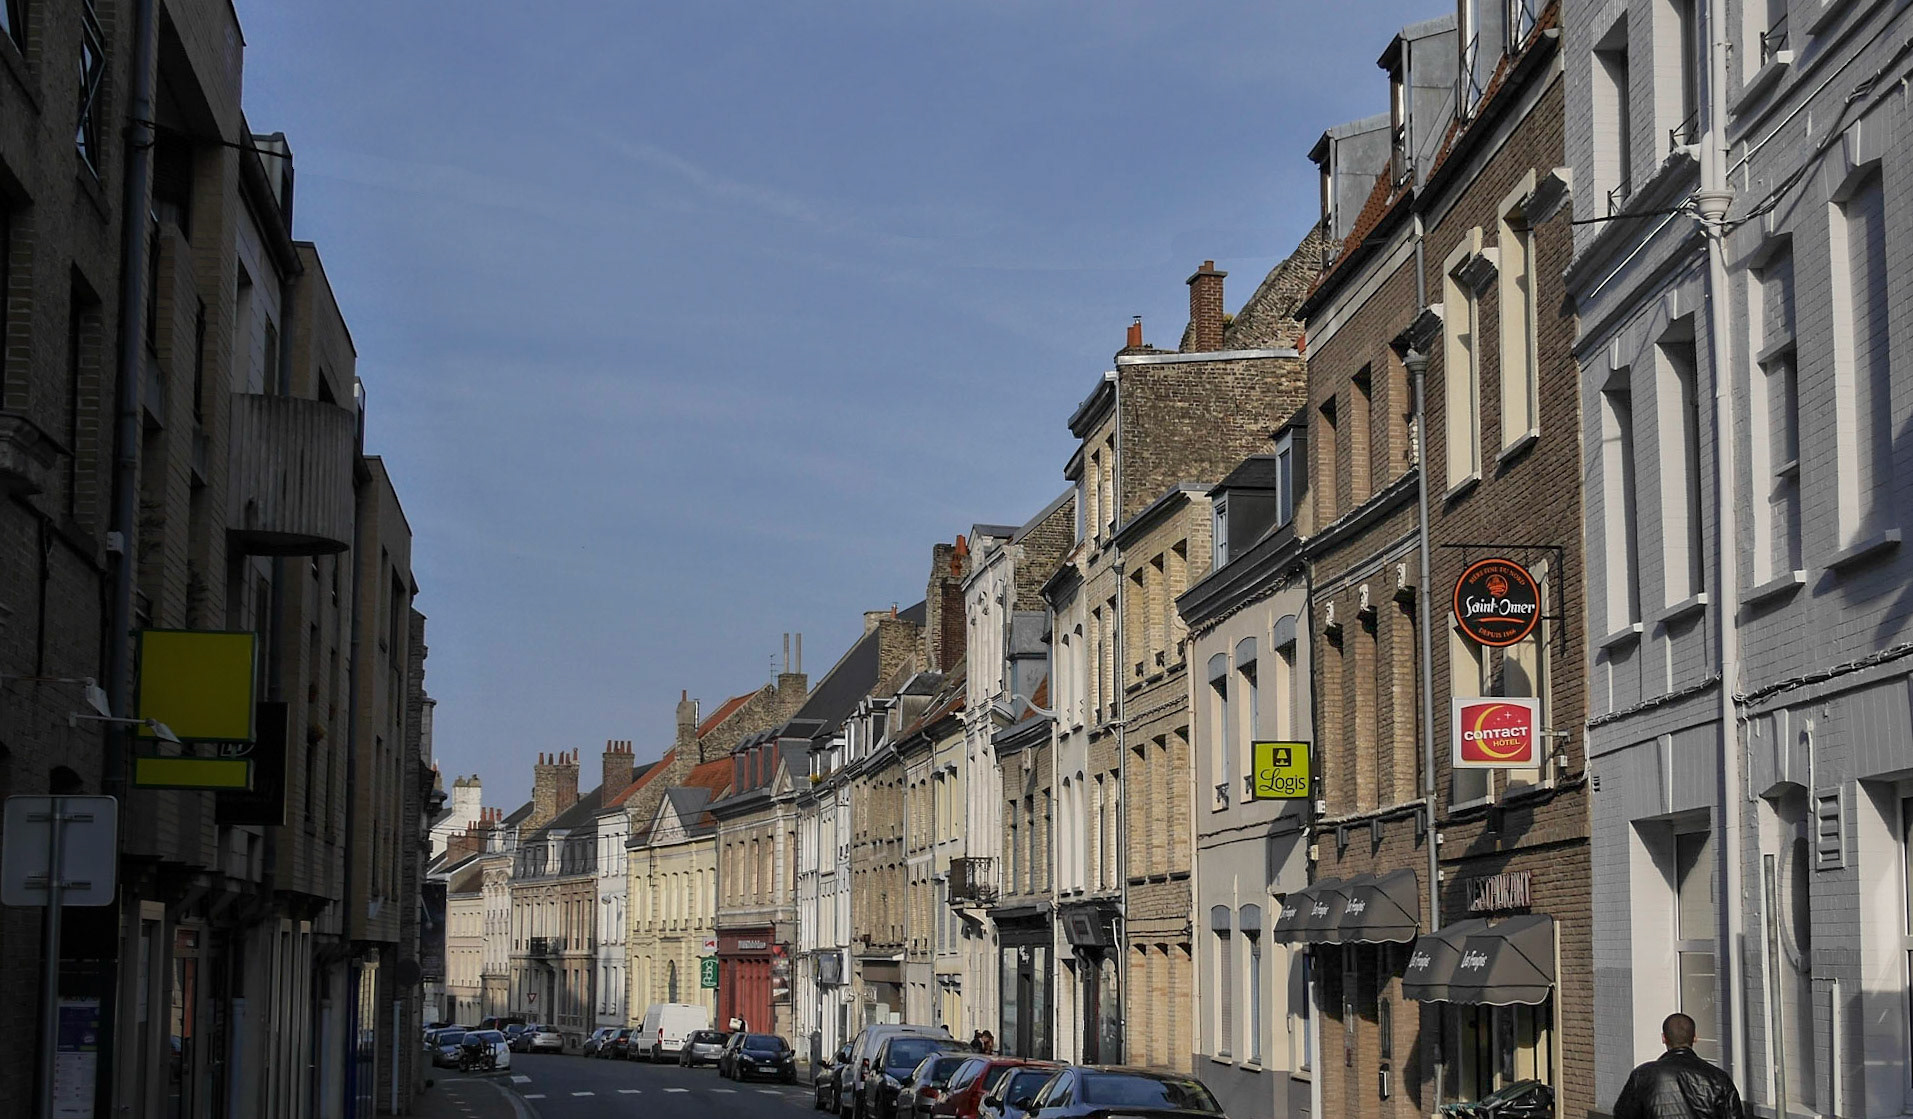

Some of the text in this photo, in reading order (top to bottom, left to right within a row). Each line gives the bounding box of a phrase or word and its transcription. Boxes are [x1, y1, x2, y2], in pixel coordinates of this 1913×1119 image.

[1465, 595, 1536, 618] Saint-Omer
[1259, 768, 1305, 794] Logis
[1465, 869, 1532, 912] RESTAURANT
